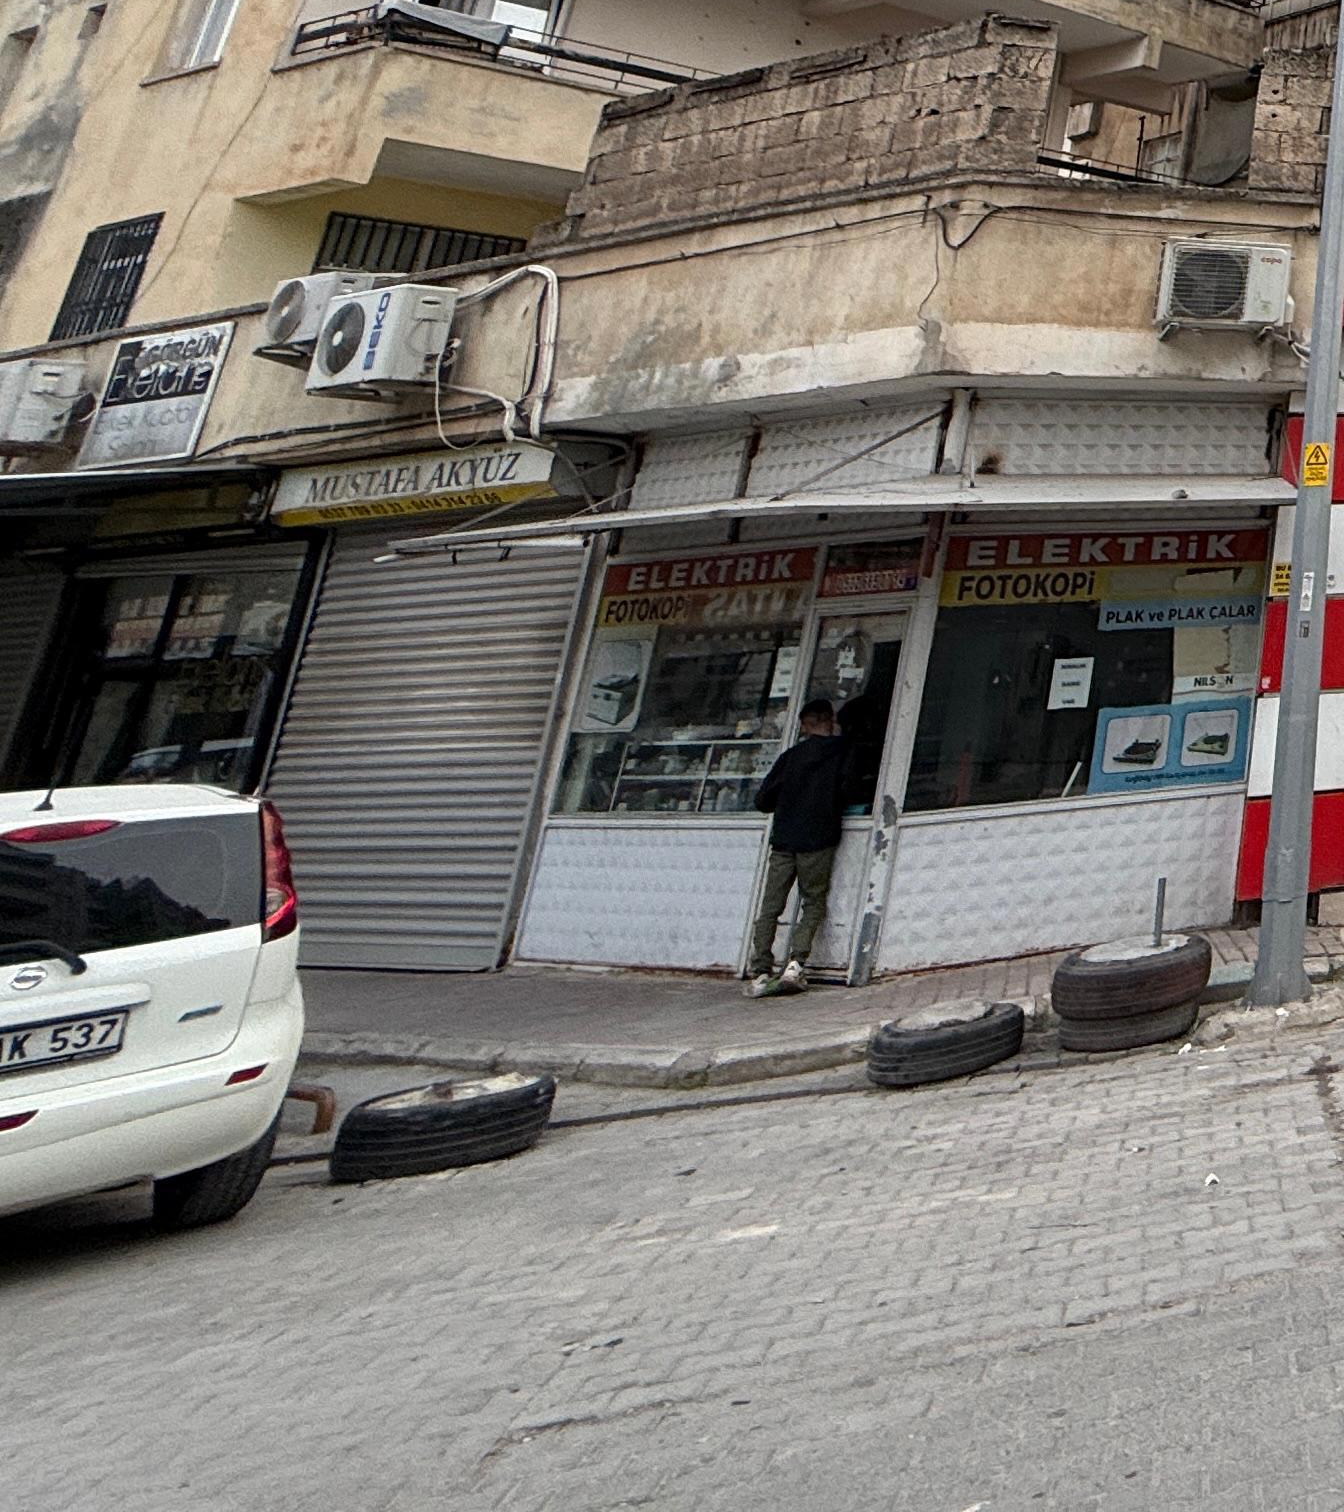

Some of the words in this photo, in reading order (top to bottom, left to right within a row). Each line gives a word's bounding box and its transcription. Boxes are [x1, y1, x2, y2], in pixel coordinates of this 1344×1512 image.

[305, 465, 421, 504] MUSTAFA
[428, 448, 522, 490] AKYÜZ
[1105, 608, 1144, 625] PLAK
[1148, 611, 1165, 623] ve
[1168, 607, 1205, 622] PLAK
[1209, 603, 1256, 620] ÇALAR
[0, 1033, 33, 1063] K
[49, 1018, 120, 1053] 537
